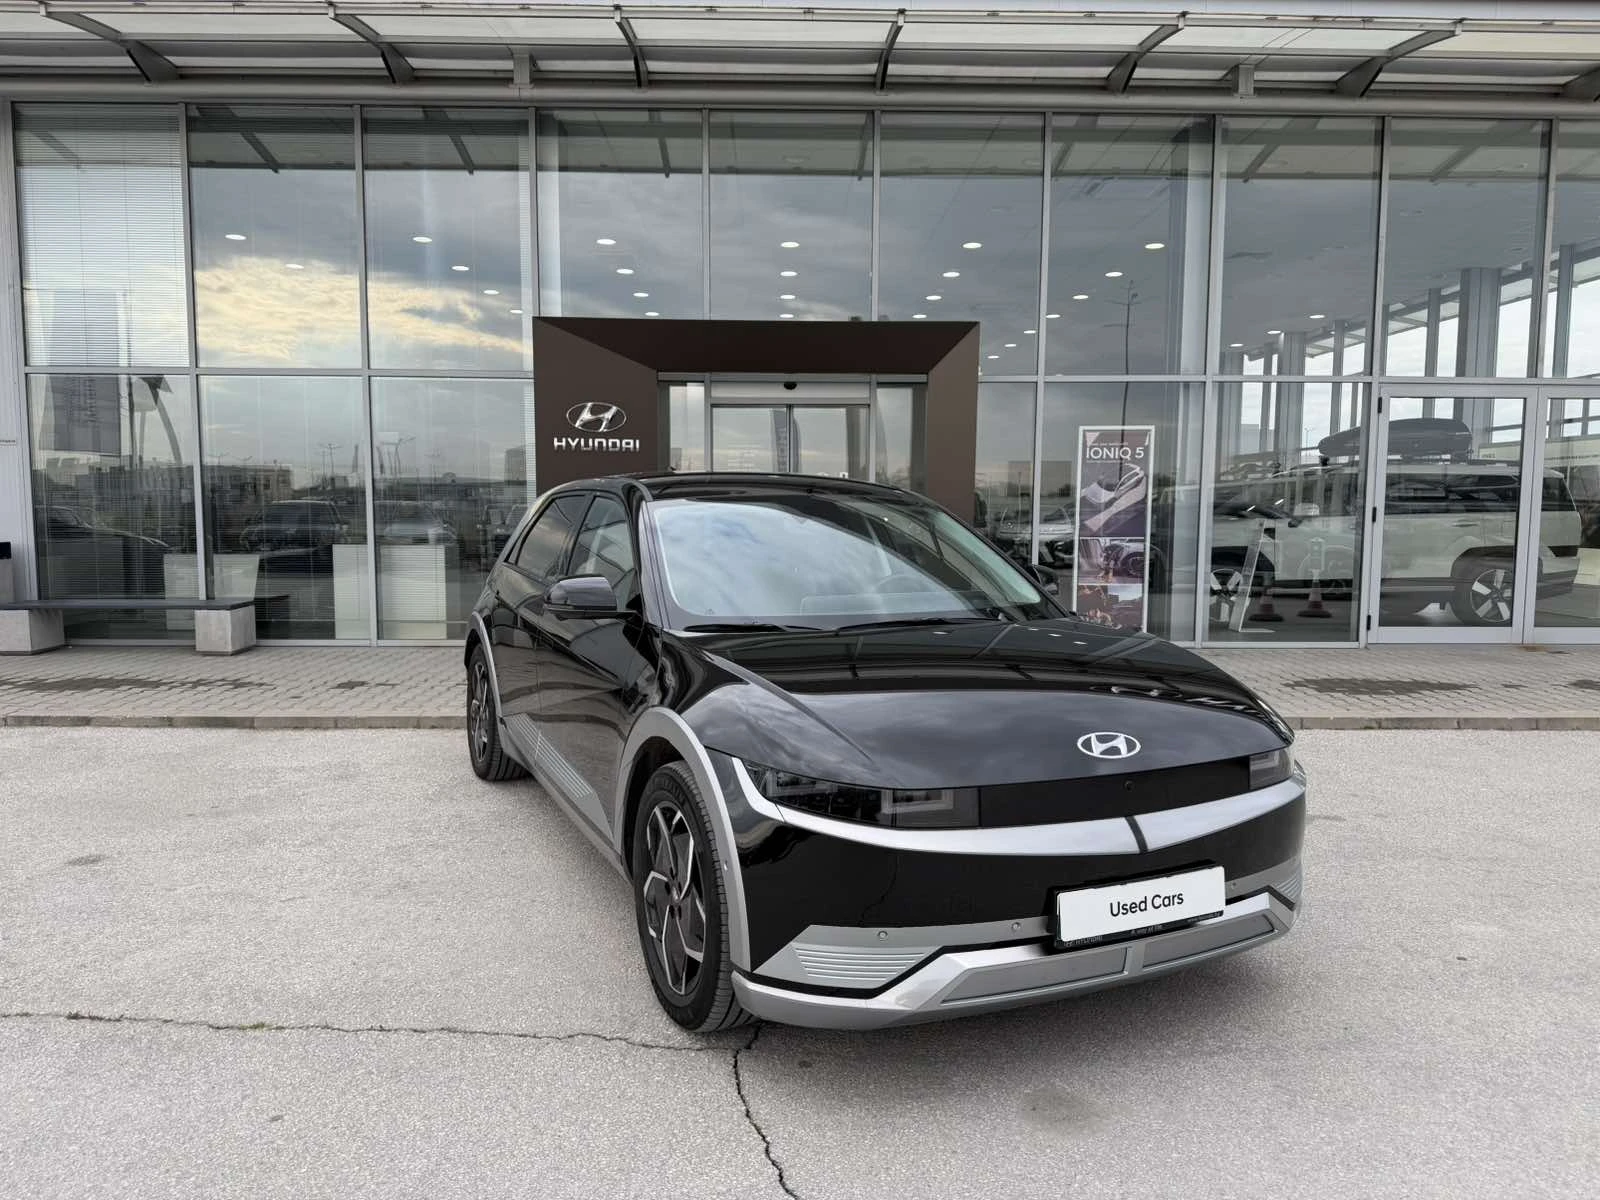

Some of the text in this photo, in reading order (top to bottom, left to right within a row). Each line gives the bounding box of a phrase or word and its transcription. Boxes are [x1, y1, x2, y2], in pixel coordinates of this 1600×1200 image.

[553, 437, 640, 452] HYUNDAI
[1086, 447, 1144, 460] IONIQ 5
[1110, 893, 1184, 917] Used Cars
